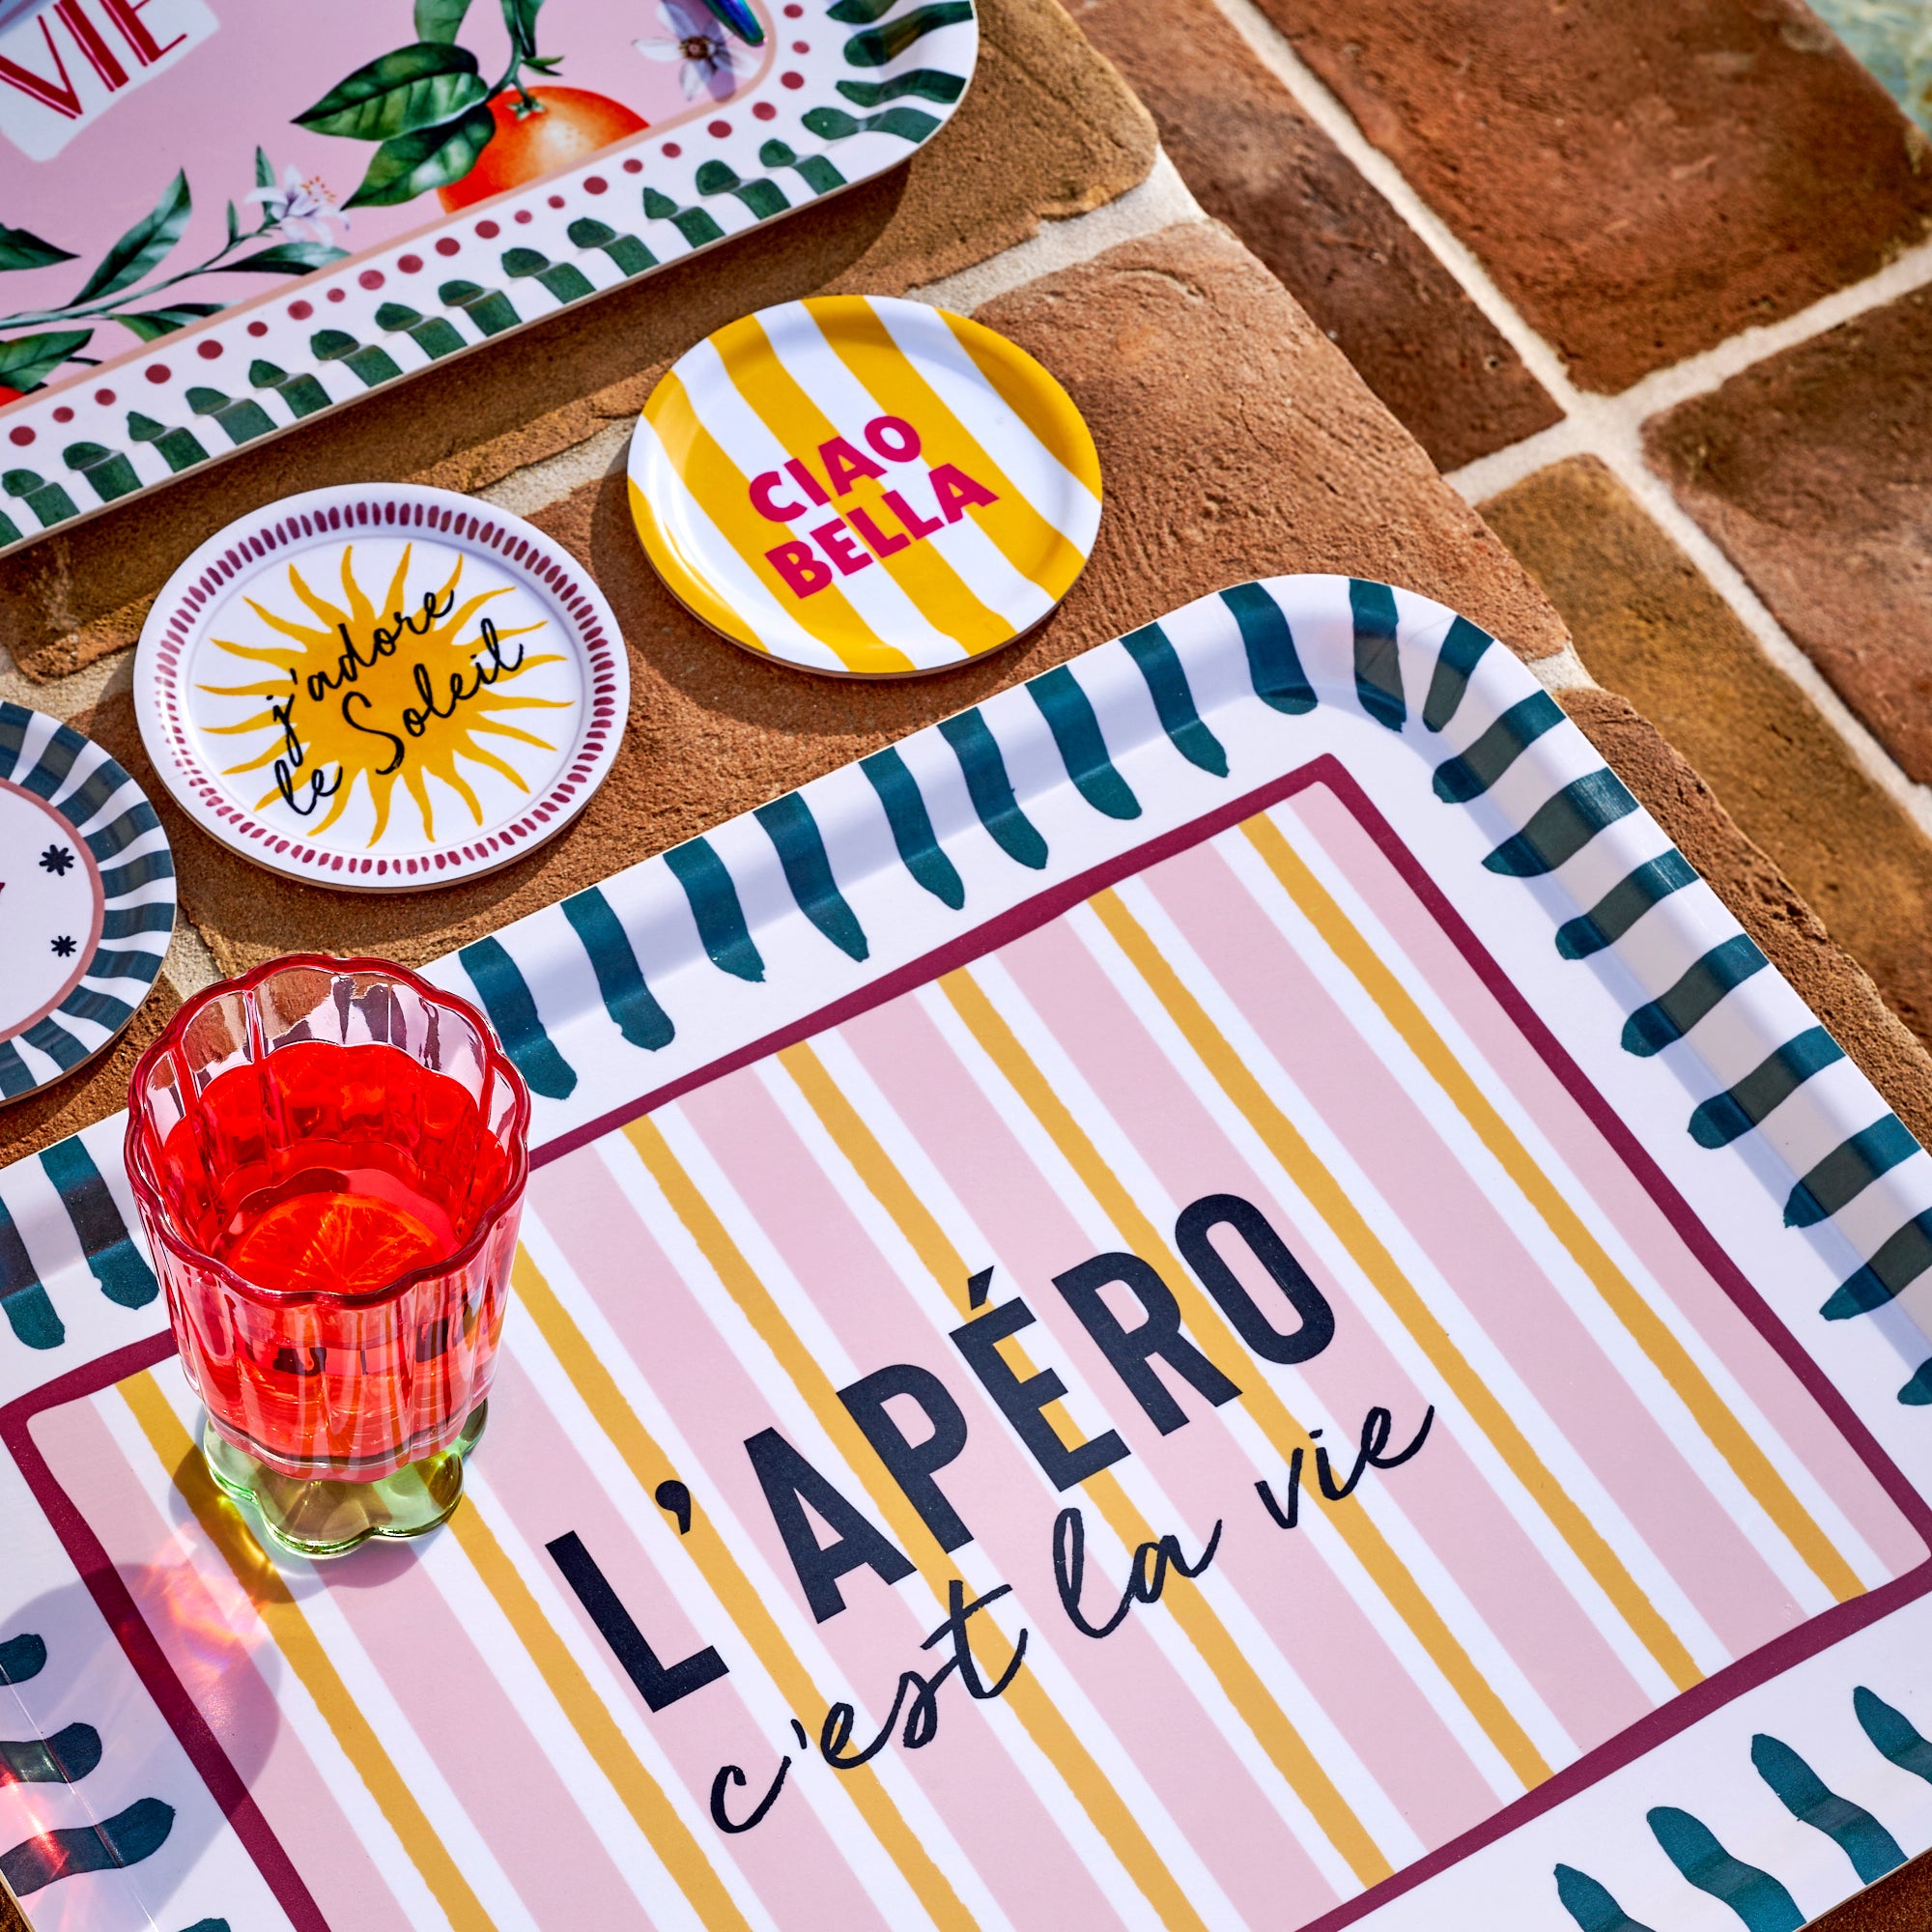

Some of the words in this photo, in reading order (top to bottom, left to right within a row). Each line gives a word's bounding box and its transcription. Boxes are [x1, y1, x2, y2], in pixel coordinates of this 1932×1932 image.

[0, 0, 187, 120] VIE
[749, 415, 923, 523] CIAO
[764, 463, 1000, 599] BELLA
[265, 588, 456, 767] j'adore
[274, 758, 343, 815] le
[342, 618, 525, 775] Soleil
[710, 1579, 1028, 1833] c'est
[1053, 1507, 1223, 1638] la
[1254, 1405, 1435, 1529] vie
